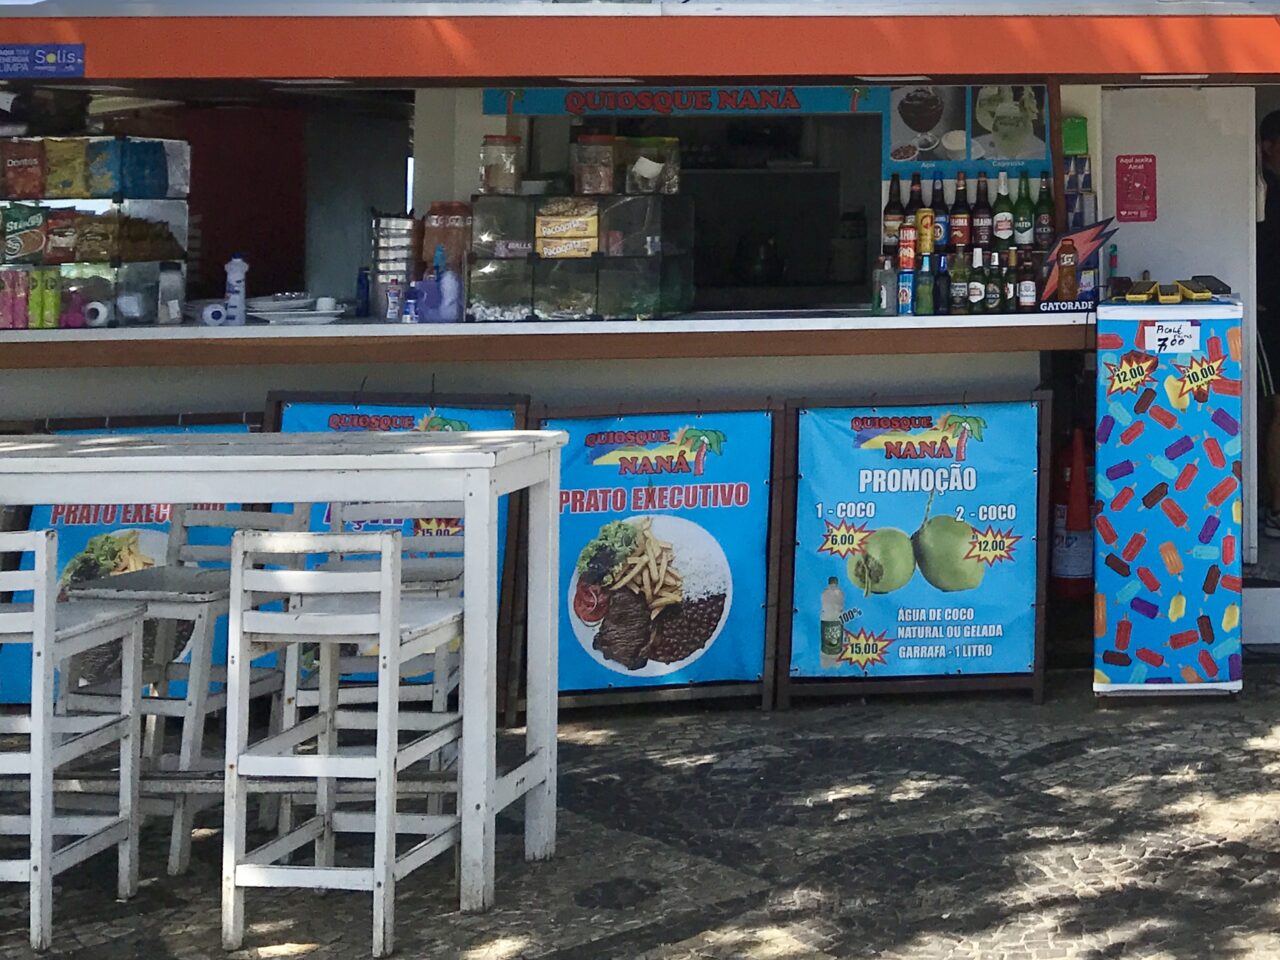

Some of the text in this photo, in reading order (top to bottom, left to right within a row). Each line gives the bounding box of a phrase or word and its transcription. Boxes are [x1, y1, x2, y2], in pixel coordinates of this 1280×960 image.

[565, 90, 712, 114] QUIOSQUE
[1115, 365, 1145, 384] 12,00
[1187, 365, 1216, 385] 10,00
[328, 414, 415, 430] QUIOSQUE
[851, 416, 933, 431] QUIOSQUE
[584, 429, 670, 447] QUIOSQUE
[884, 436, 953, 459] NANÁ
[618, 450, 691, 475] NANÁ
[859, 464, 977, 495] PROMOÇÃO
[559, 483, 749, 514] PRATO EXECUTIVO
[51, 503, 117, 525] PRATO
[815, 503, 823, 518] 1
[836, 502, 876, 518] COCO
[955, 506, 964, 521] 2
[978, 505, 1017, 520] COCO
[831, 534, 855, 546] 6,00
[978, 540, 1005, 552] 12,00
[839, 608, 863, 625] 100%
[898, 607, 974, 622] ÁGUA DE COCO
[898, 625, 1003, 638] NATURAL OU GELADA
[850, 643, 878, 654] 15,00
[899, 645, 946, 658] GARRAFA
[955, 645, 961, 657] 1
[962, 645, 993, 657] LITRO
